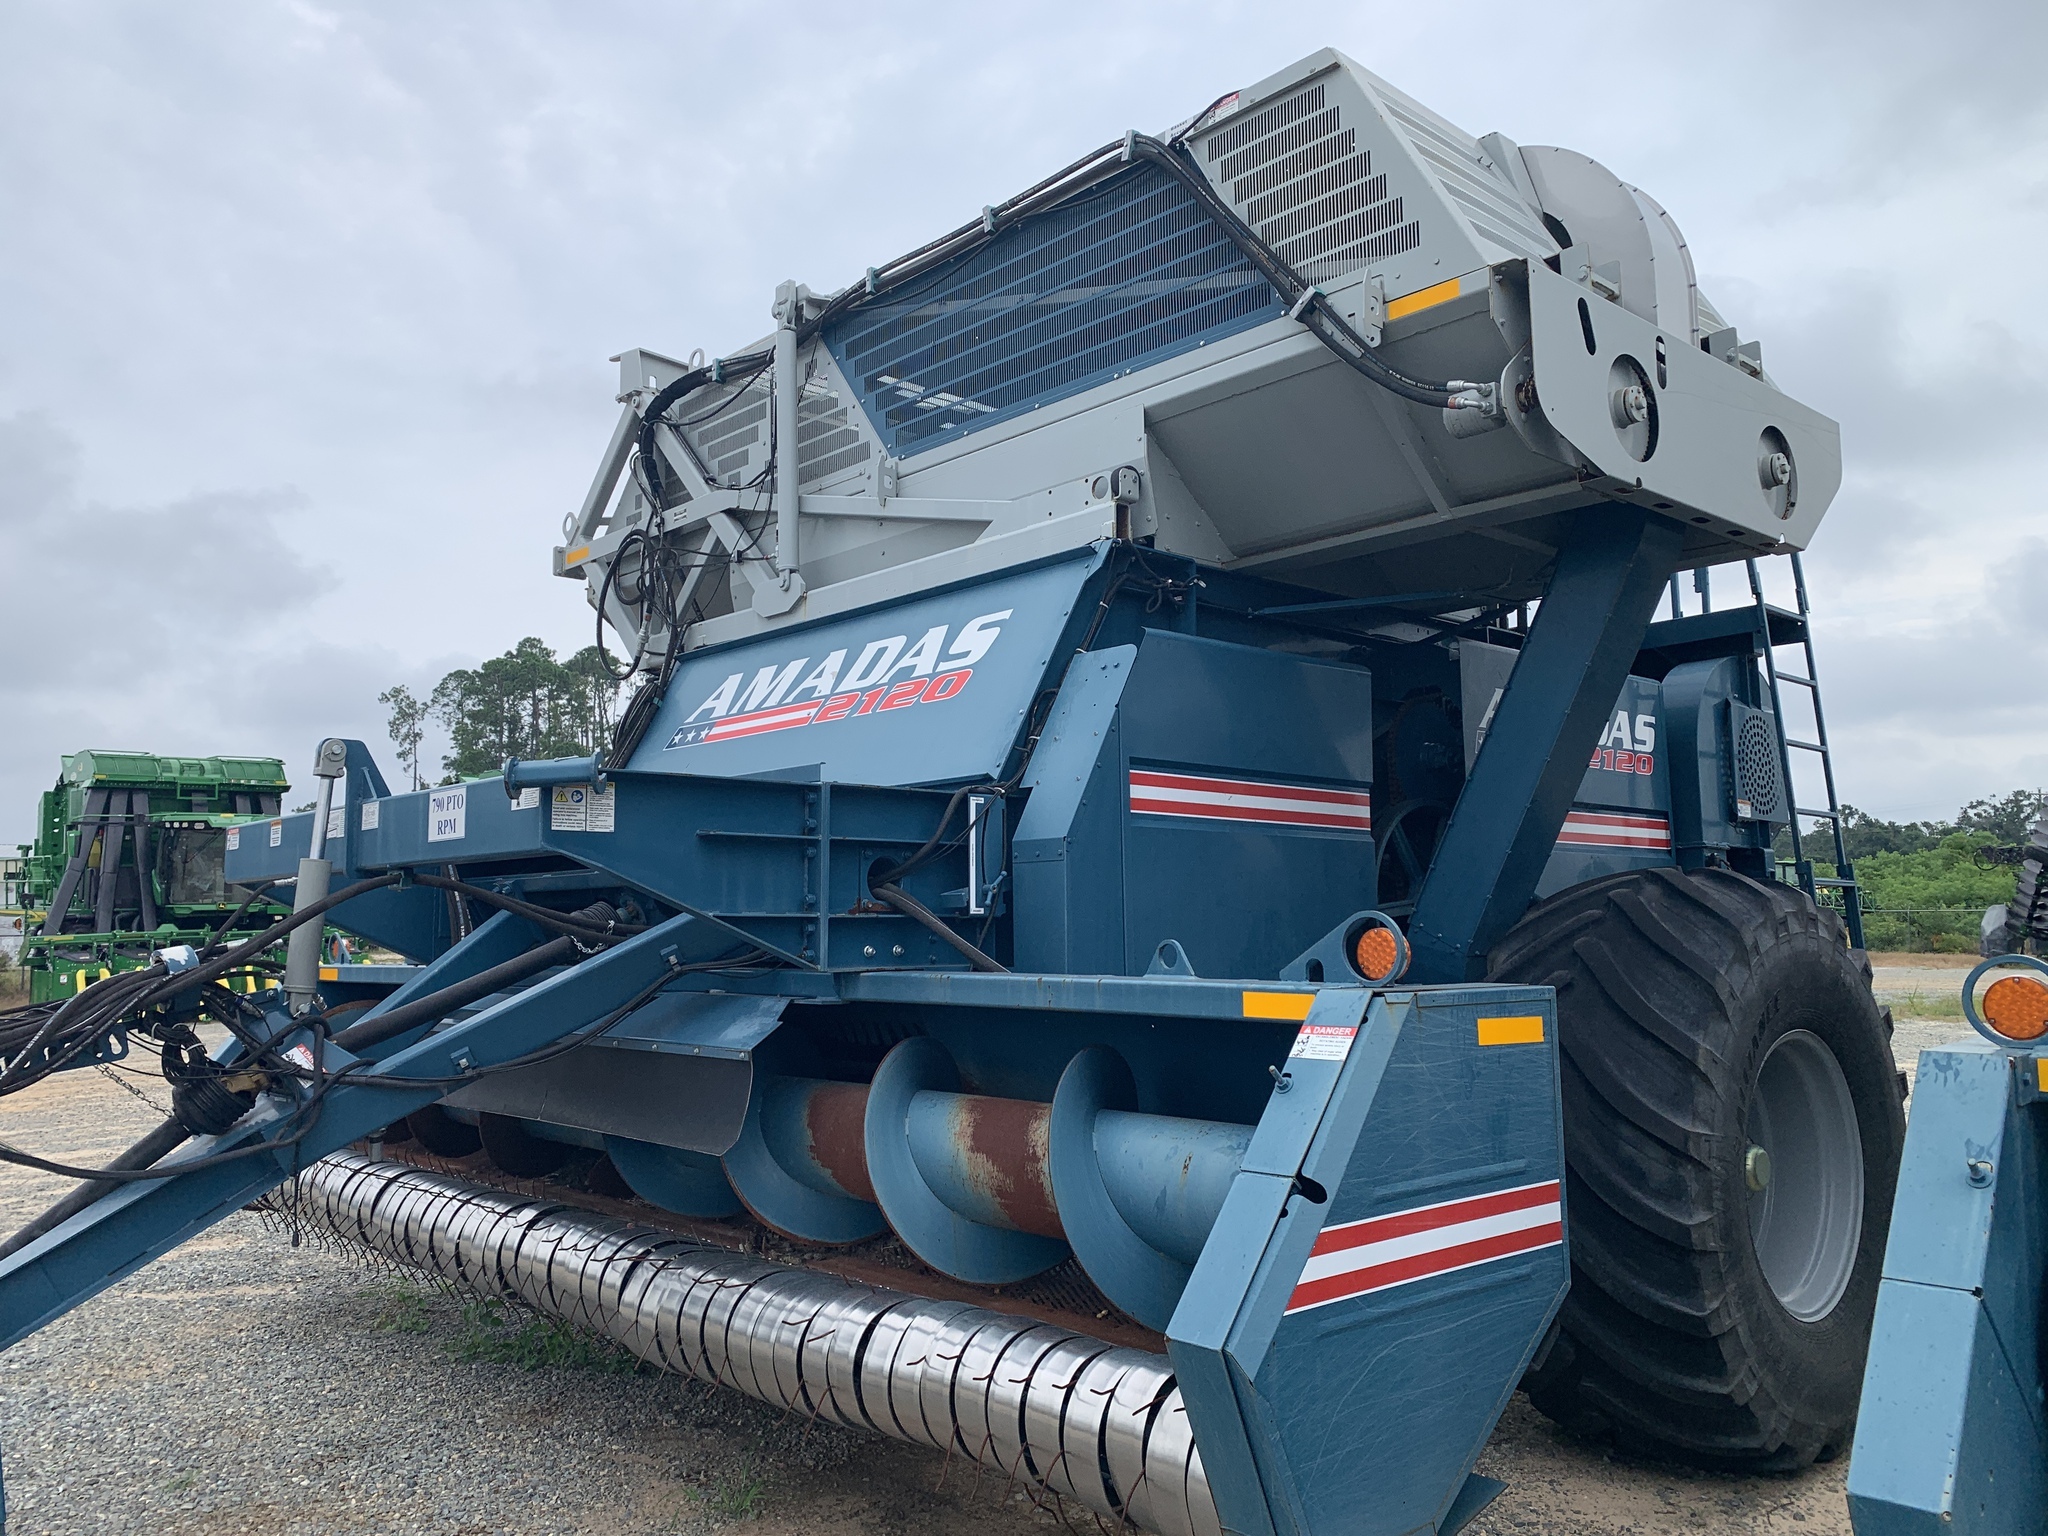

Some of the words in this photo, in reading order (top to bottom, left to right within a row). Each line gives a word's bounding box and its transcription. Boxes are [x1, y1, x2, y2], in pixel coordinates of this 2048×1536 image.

[684, 608, 1014, 724] AMADAS
[812, 668, 973, 725] 2120
[446, 793, 464, 811] PTO
[437, 818, 456, 835] RPM
[1313, 1026, 1352, 1036] DANGER
